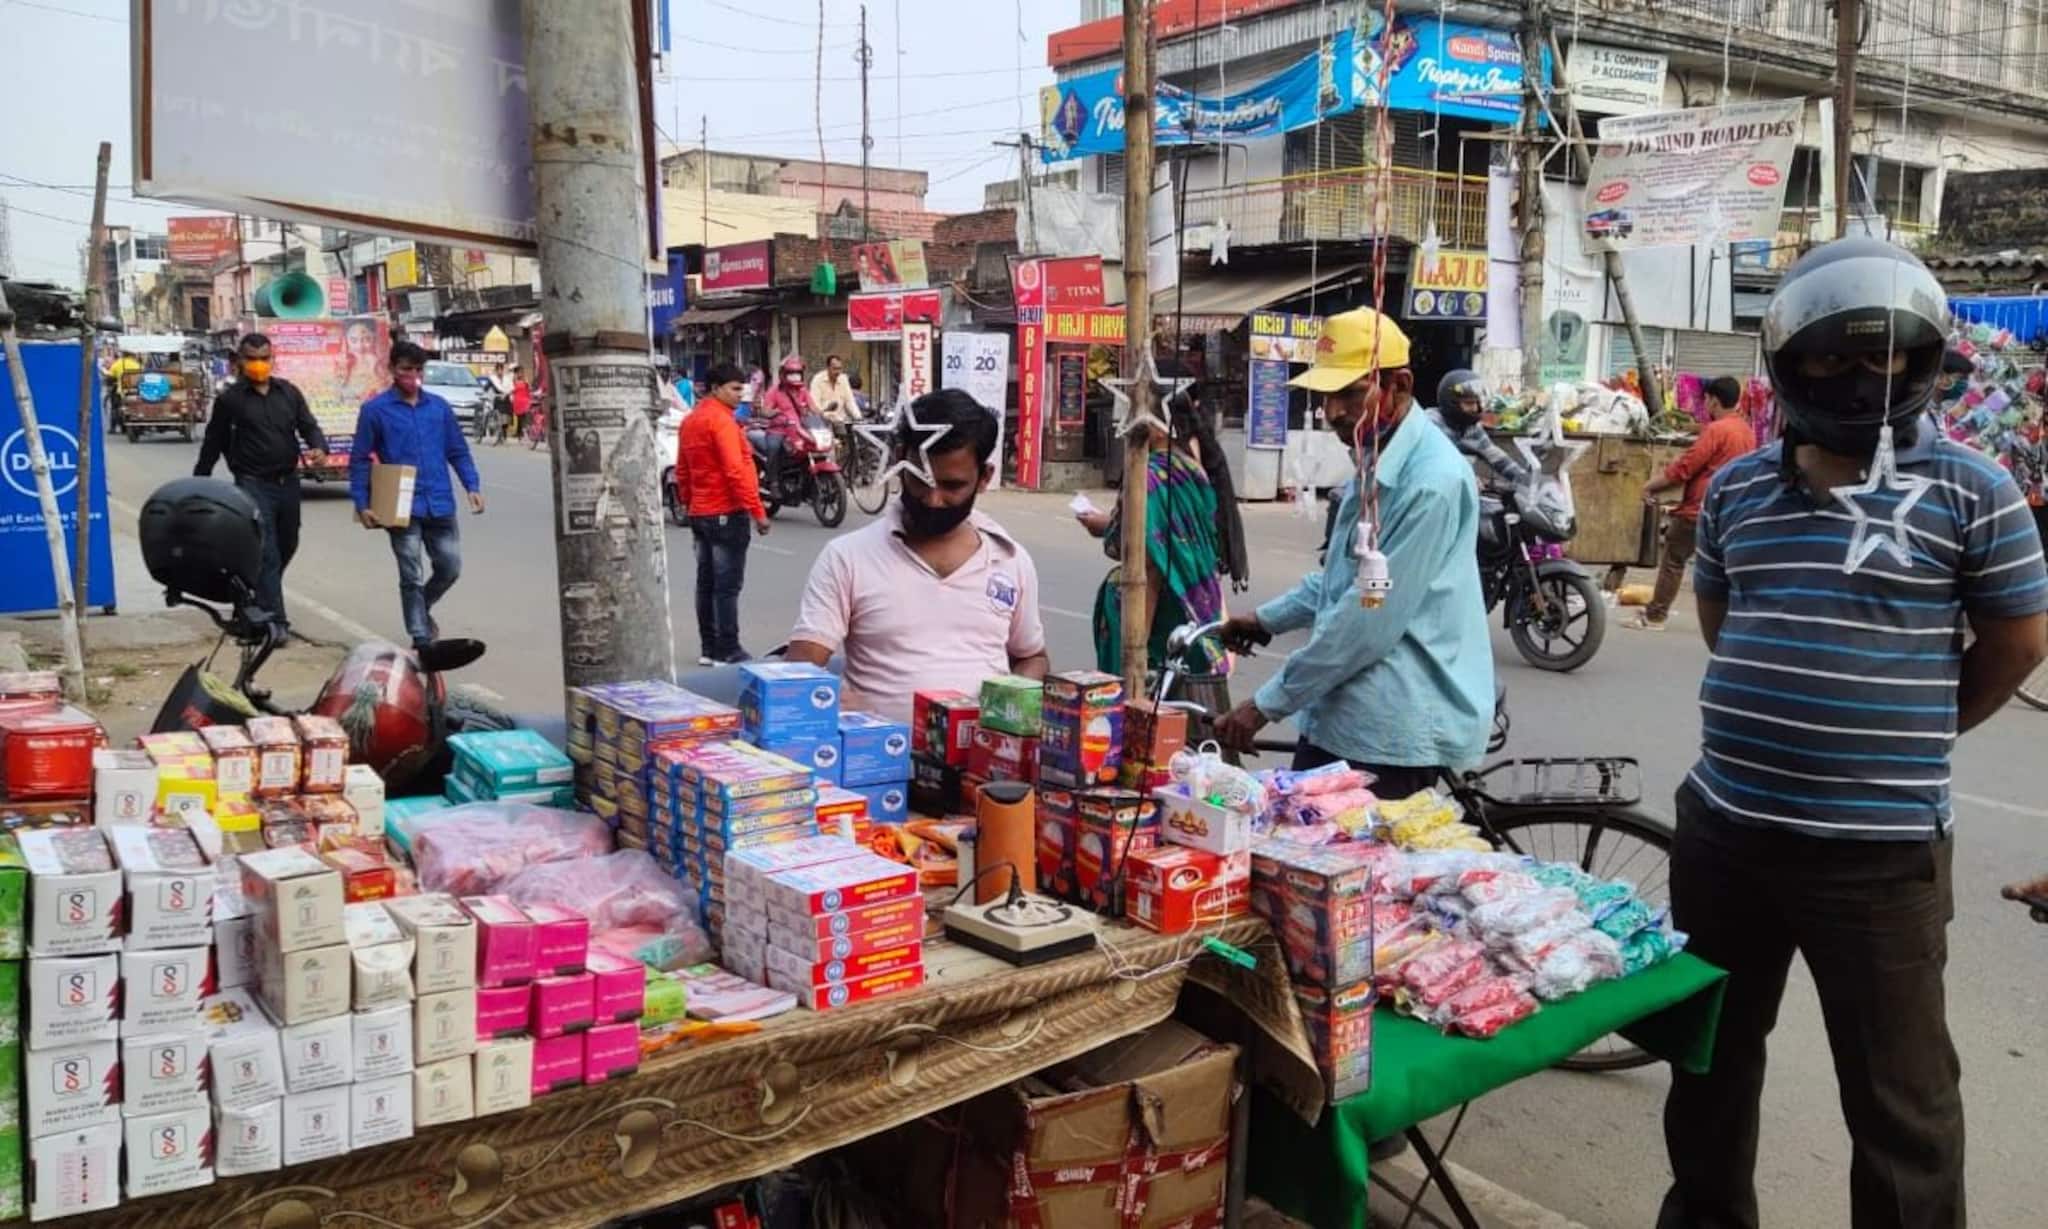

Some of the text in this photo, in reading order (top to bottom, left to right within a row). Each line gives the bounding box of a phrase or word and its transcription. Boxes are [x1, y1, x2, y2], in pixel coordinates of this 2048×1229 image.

[1066, 285, 1100, 298] TITAN
[1023, 326, 1036, 484] BIRYANI
[11, 451, 78, 471] DLL
